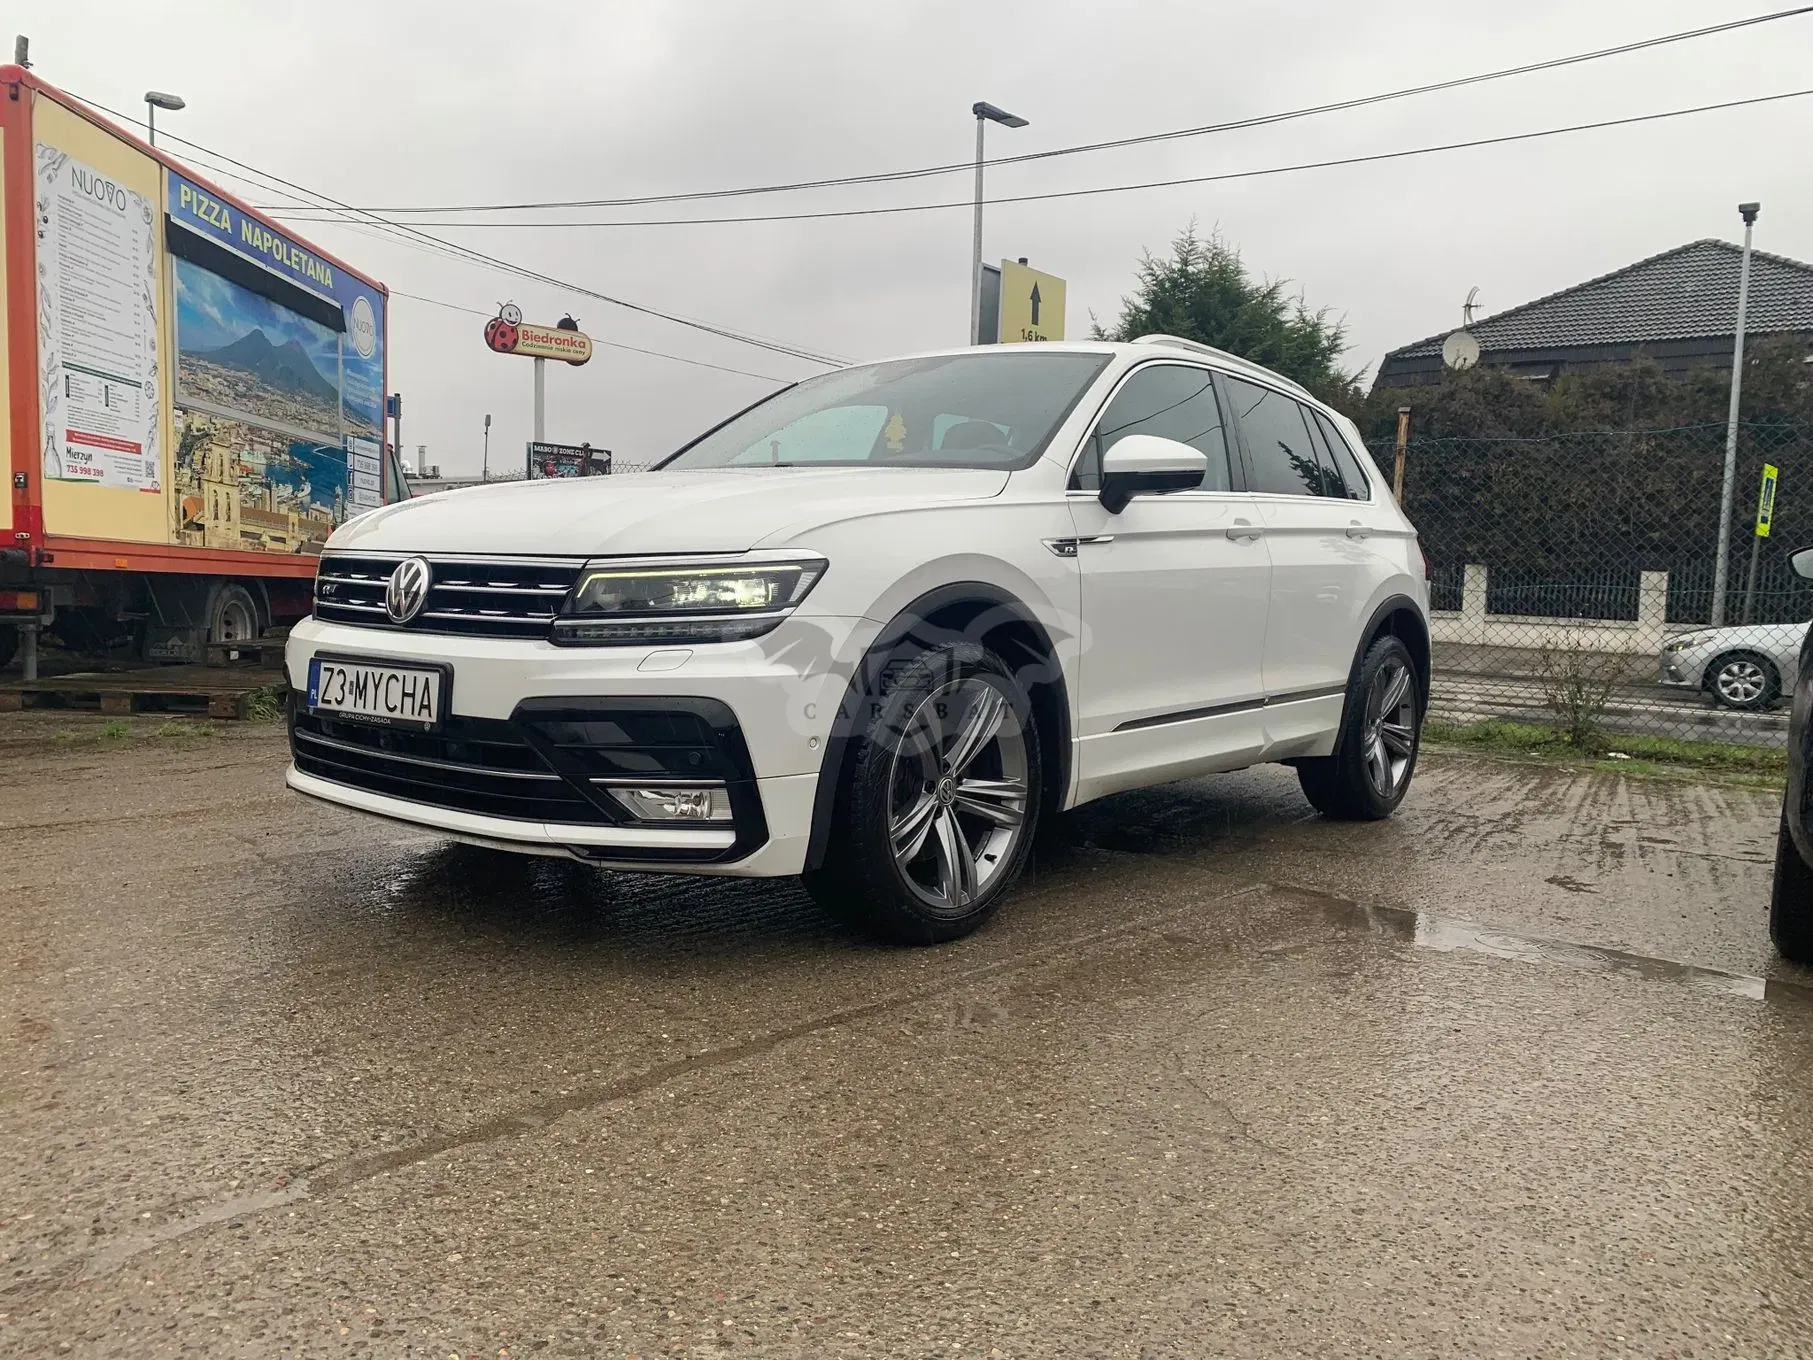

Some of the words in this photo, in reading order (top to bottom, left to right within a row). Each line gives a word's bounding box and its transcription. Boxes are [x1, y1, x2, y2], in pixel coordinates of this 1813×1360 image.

[72, 166, 126, 211] NUOVO
[180, 183, 232, 234] PIZZA
[241, 218, 334, 289] NAPOLETANA
[522, 329, 586, 349] Biedronka
[1021, 328, 1033, 342] 1,6
[66, 446, 93, 464] Mierzyn
[310, 688, 318, 700] PL
[320, 666, 347, 706] Z3
[353, 669, 433, 718] MYCHA
